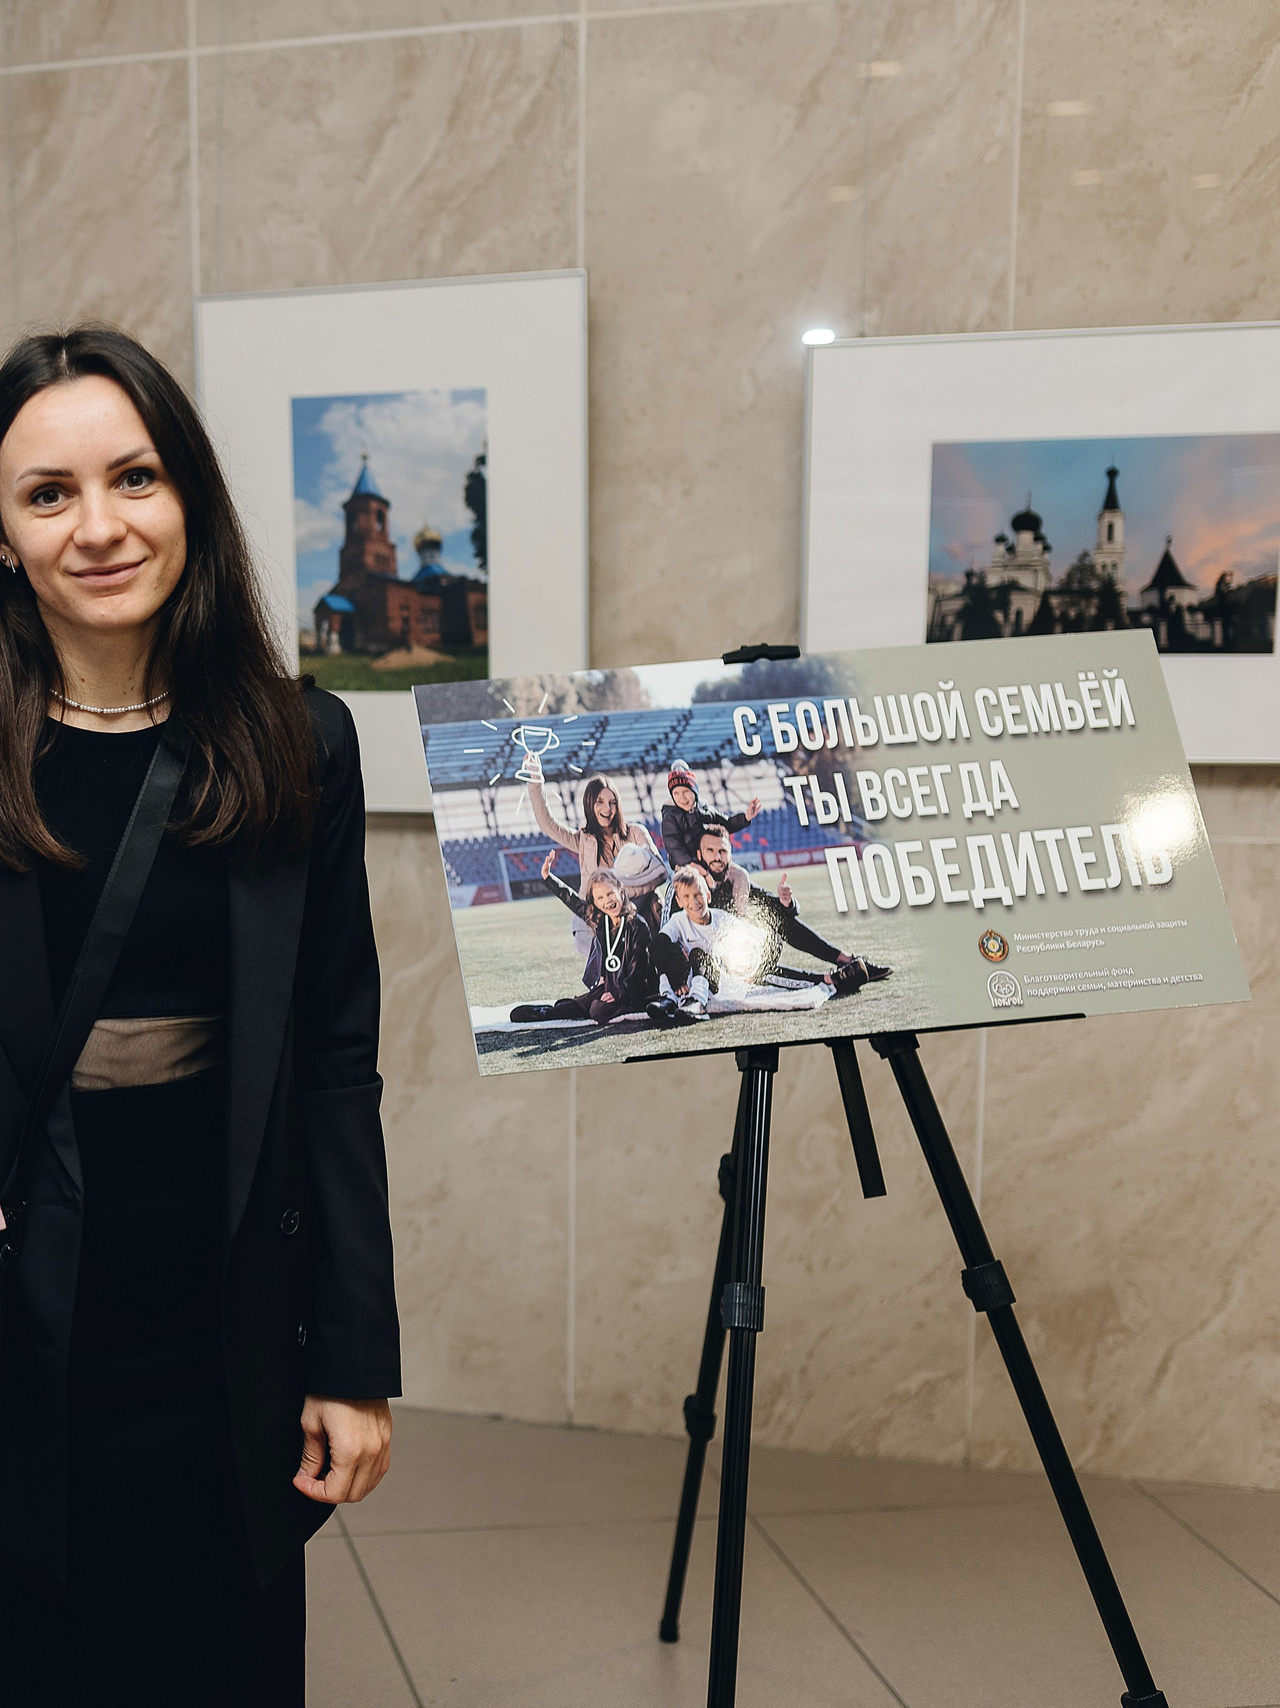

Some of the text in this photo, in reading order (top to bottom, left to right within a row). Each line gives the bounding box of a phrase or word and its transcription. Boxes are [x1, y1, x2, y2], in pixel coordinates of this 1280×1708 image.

[733, 668, 1136, 756] С БОЛЬШОЙ СЕМЬЁЙ
[784, 772, 852, 826] ТЫ
[1013, 929, 1074, 942] Министерство
[1075, 927, 1099, 938] труда
[1107, 920, 1155, 933] социальной
[1156, 919, 1188, 929] защиты
[1016, 939, 1105, 954] Республики Беларусь
[1023, 967, 1134, 984] Благотворительный фонд
[1027, 984, 1077, 997] поддержки
[1107, 976, 1162, 989] материнства
[1170, 972, 1203, 985] детства
